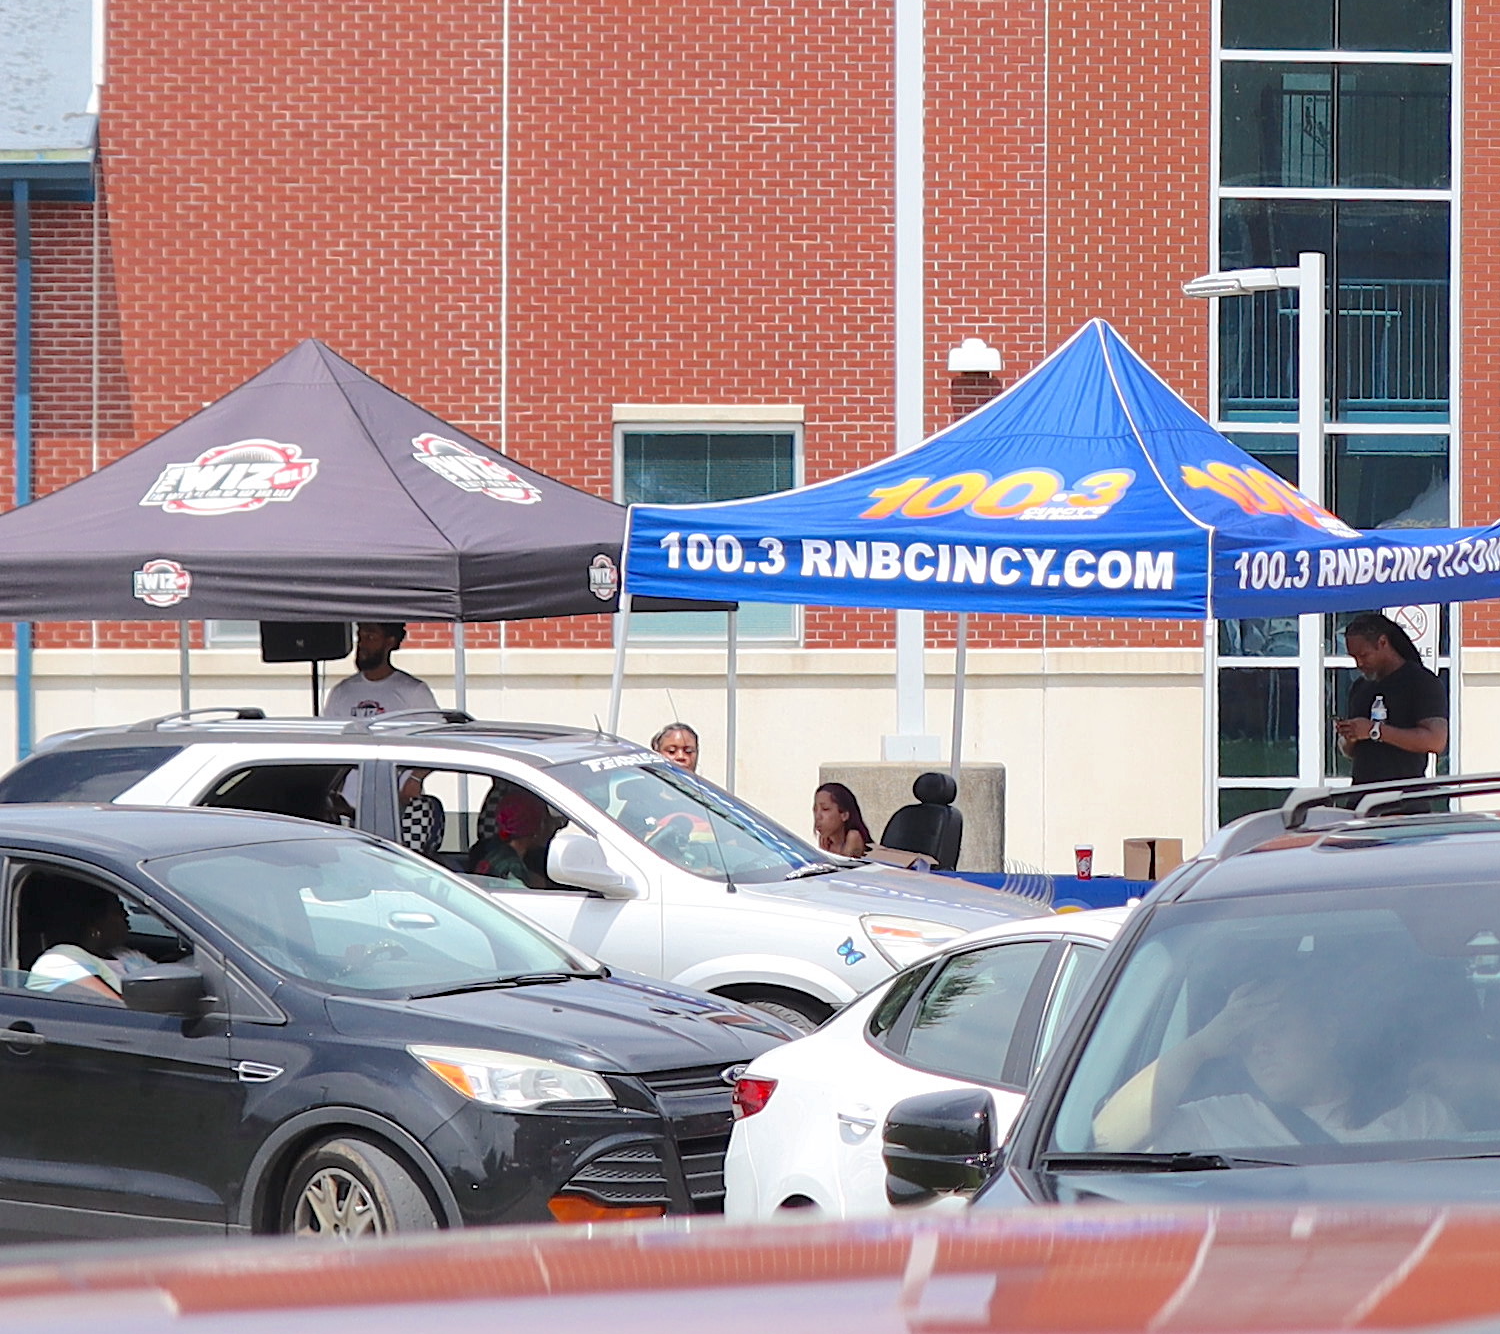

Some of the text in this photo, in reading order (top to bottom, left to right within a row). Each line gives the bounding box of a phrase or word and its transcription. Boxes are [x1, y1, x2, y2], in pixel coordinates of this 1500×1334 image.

[177, 463, 287, 492] WIZ
[858, 471, 1131, 519] 100.3
[142, 572, 178, 590] WIZ
[659, 533, 1176, 591] 100.3 RNBCINCY.COM
[1234, 549, 1311, 591] 100.3
